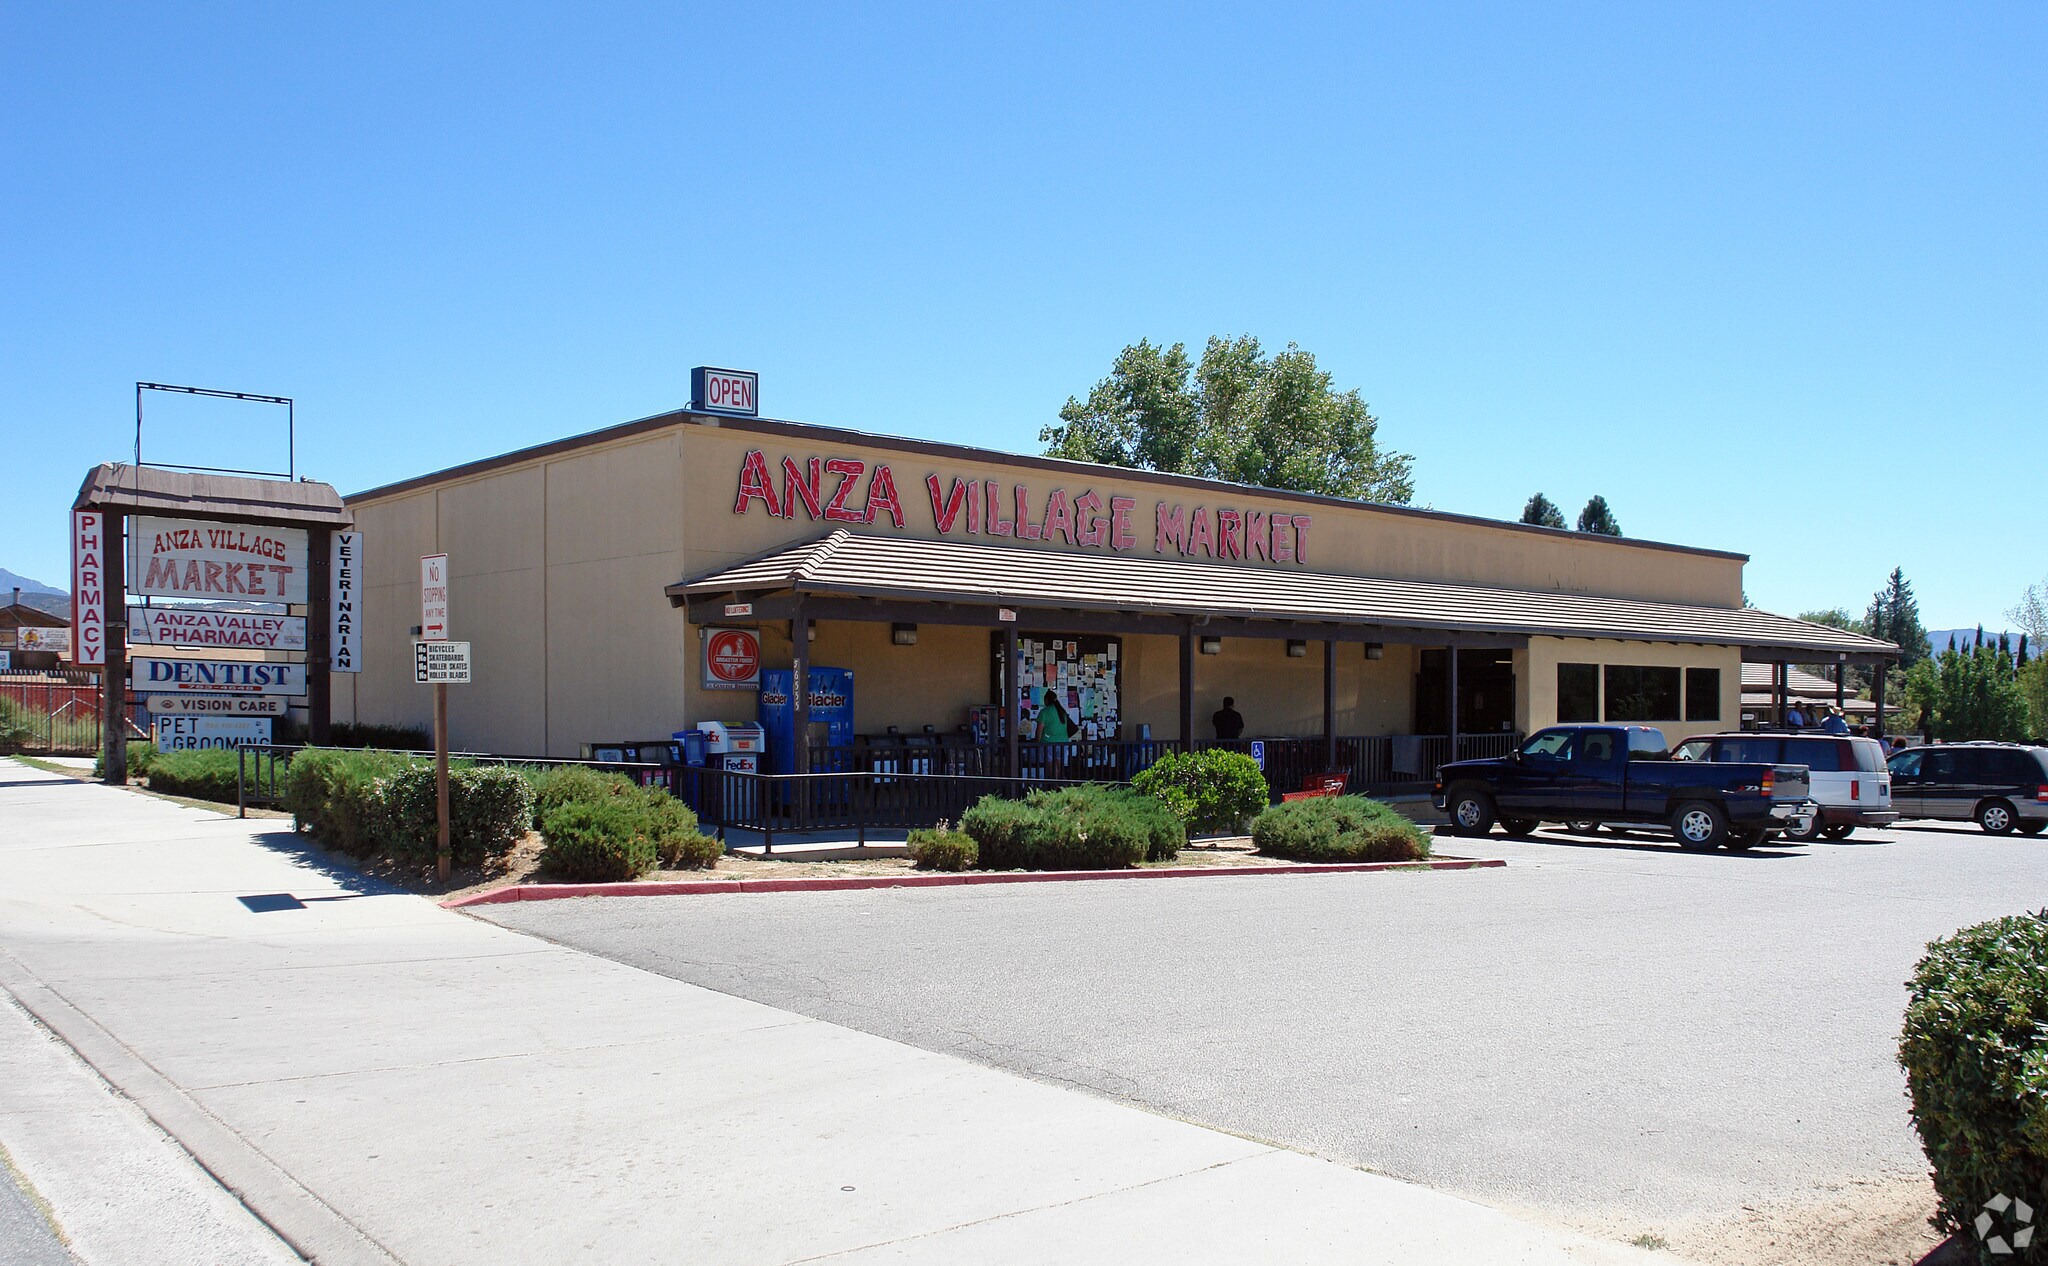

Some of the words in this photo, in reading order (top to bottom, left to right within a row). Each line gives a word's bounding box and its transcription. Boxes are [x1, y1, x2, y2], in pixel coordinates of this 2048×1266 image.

[709, 377, 751, 408] OPEN
[734, 450, 906, 528] ANZA
[927, 473, 1137, 551] VILLAGE
[1155, 502, 1313, 564] MARKET
[153, 529, 203, 554] ANZA
[207, 529, 286, 562] VILLAGE
[145, 557, 293, 596] MARKET
[429, 566, 440, 582] NO
[80, 516, 101, 661] PHARMACY
[424, 586, 446, 603] STOPPING
[338, 535, 352, 668] VETERINARIAN
[154, 612, 211, 627] ANZA
[214, 615, 284, 630] VALLEY
[425, 608, 434, 618] ANY
[435, 607, 445, 617] TIME
[159, 627, 278, 646] PHARMACY
[429, 645, 455, 653] BICYCLES
[148, 661, 290, 685] DENTIST
[429, 671, 447, 679] ROLLER
[449, 671, 468, 679] BLADES
[181, 700, 232, 711] VISION
[238, 701, 277, 711] CARE
[763, 692, 787, 705] Glacier
[161, 717, 199, 734] PET
[703, 730, 720, 743] edEx
[726, 759, 754, 771] FedEx
